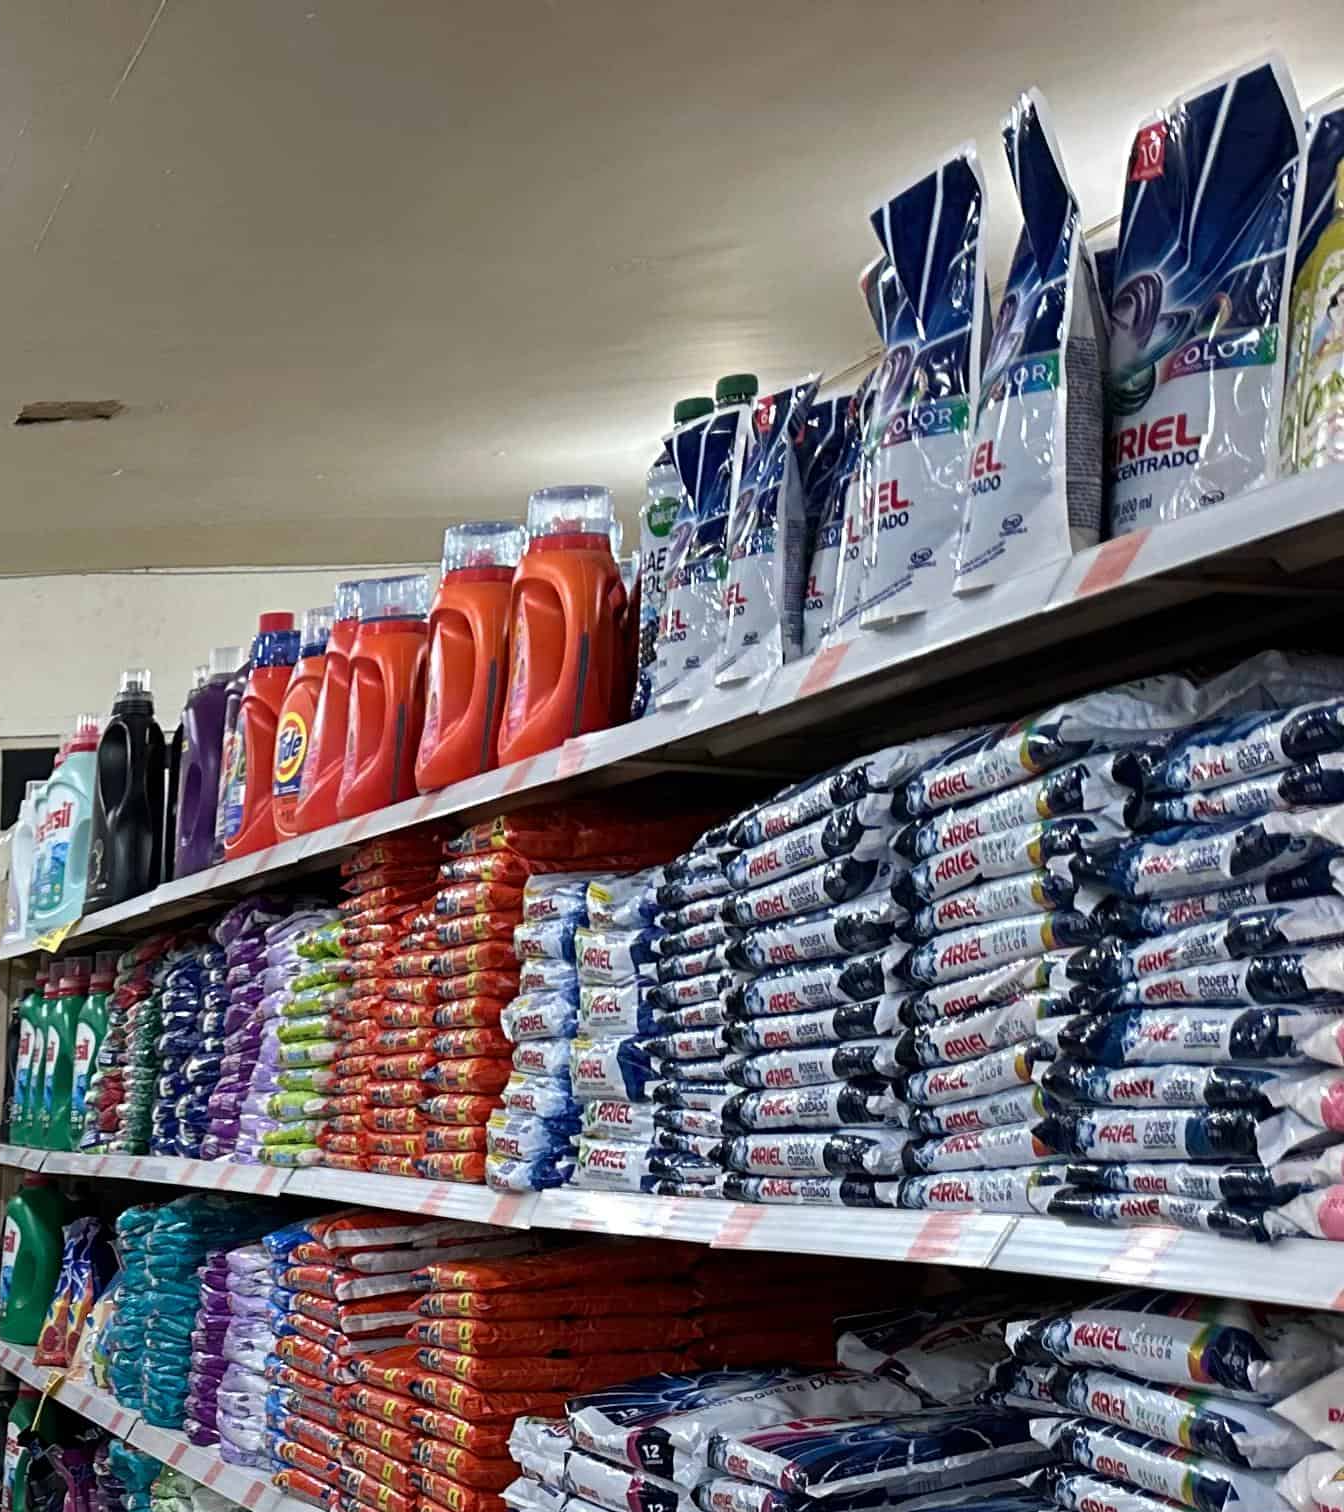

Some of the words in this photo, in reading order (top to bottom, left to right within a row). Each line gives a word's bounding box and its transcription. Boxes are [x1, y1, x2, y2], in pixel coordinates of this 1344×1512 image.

[928, 770, 974, 802] ARIEL
[941, 817, 985, 848] ARIEL
[749, 852, 782, 878] ARIEL
[755, 895, 789, 916] ARIEL
[584, 950, 612, 970] ARIEL
[940, 938, 987, 969] ARIEL
[518, 1014, 547, 1032] ARIEL
[945, 1033, 990, 1060] ARIEL
[578, 1060, 606, 1080] ARIEL
[766, 1068, 799, 1085] ARIEL
[598, 1103, 632, 1124] ARIEL
[1099, 1125, 1137, 1144] ARIEL
[751, 1148, 784, 1166] ARIEL
[929, 1182, 974, 1203] ARIEL
[1073, 1323, 1129, 1352] ARIEL
[1132, 1344, 1172, 1360] COLOR
[1091, 1390, 1130, 1425] ARIEL
[642, 1445, 660, 1459] 12
